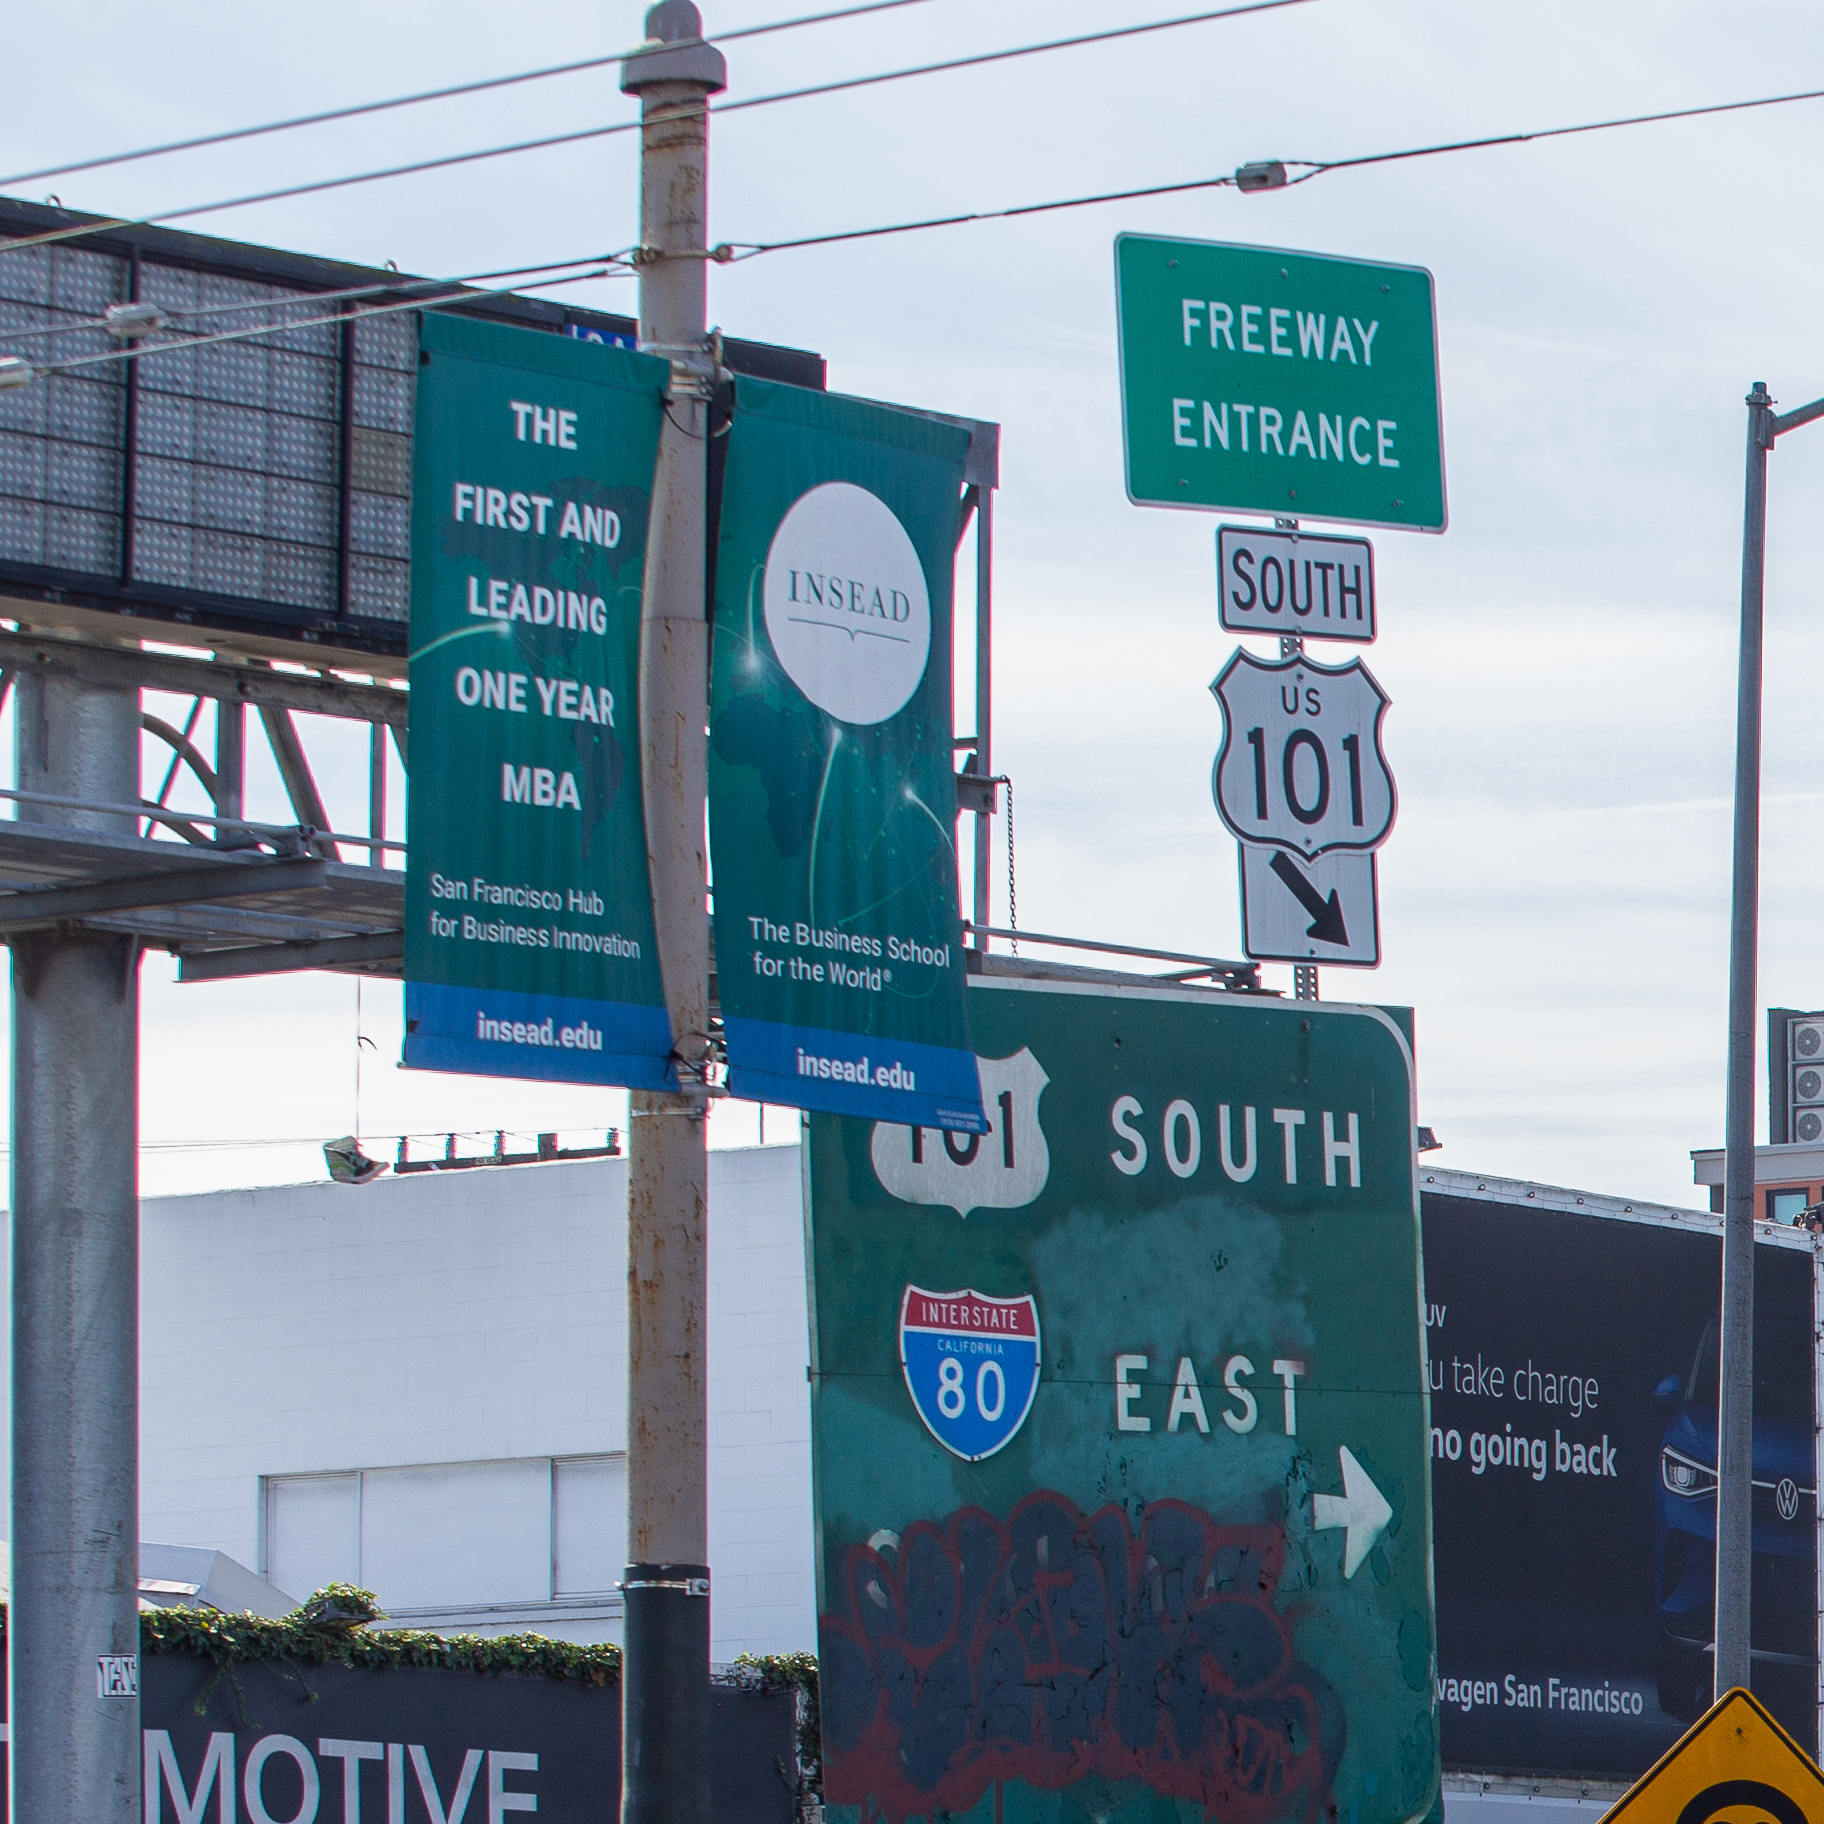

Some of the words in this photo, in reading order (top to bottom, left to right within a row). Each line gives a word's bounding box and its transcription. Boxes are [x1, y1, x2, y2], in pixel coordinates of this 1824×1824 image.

[1182, 298, 1379, 367] FREEWAY
[511, 401, 577, 450] THE
[1172, 397, 1400, 468] ENTRANCE
[454, 484, 553, 536] FIRST
[560, 500, 621, 549] AND
[467, 576, 607, 636] LEADING
[787, 570, 910, 624] INSEAD
[1231, 548, 1363, 621] SOUTH
[456, 667, 527, 714] ONE
[537, 677, 615, 727] YEAR
[1282, 685, 1322, 717] US
[502, 762, 581, 811] MBA
[1247, 726, 1364, 827] 101
[430, 874, 468, 903] San
[473, 879, 564, 911] Francisco
[569, 889, 604, 916] Hub
[430, 912, 457, 936] for
[463, 915, 548, 946] Business
[552, 928, 641, 959] Innovation
[749, 916, 789, 945] The
[794, 922, 882, 958] Business
[886, 934, 950, 968] School
[754, 951, 786, 976] for
[790, 955, 824, 981] the
[477, 1010, 603, 1051] insead.edu
[797, 1048, 916, 1091] insead.edu
[1110, 1095, 1361, 1188] SOUTH
[921, 1301, 1019, 1331] INTERSTATE
[1425, 1304, 1447, 1328] UV
[937, 1338, 1004, 1357] CALIFORNIA
[937, 1358, 1006, 1423] 80
[1116, 1354, 1305, 1436] EAST
[1452, 1353, 1504, 1398] take
[1514, 1359, 1599, 1418] charge
[1429, 1427, 1462, 1460] no
[1470, 1424, 1546, 1481] going
[1555, 1429, 1618, 1477] back
[1504, 1674, 1542, 1708] San
[1548, 1678, 1644, 1715] Francisco
